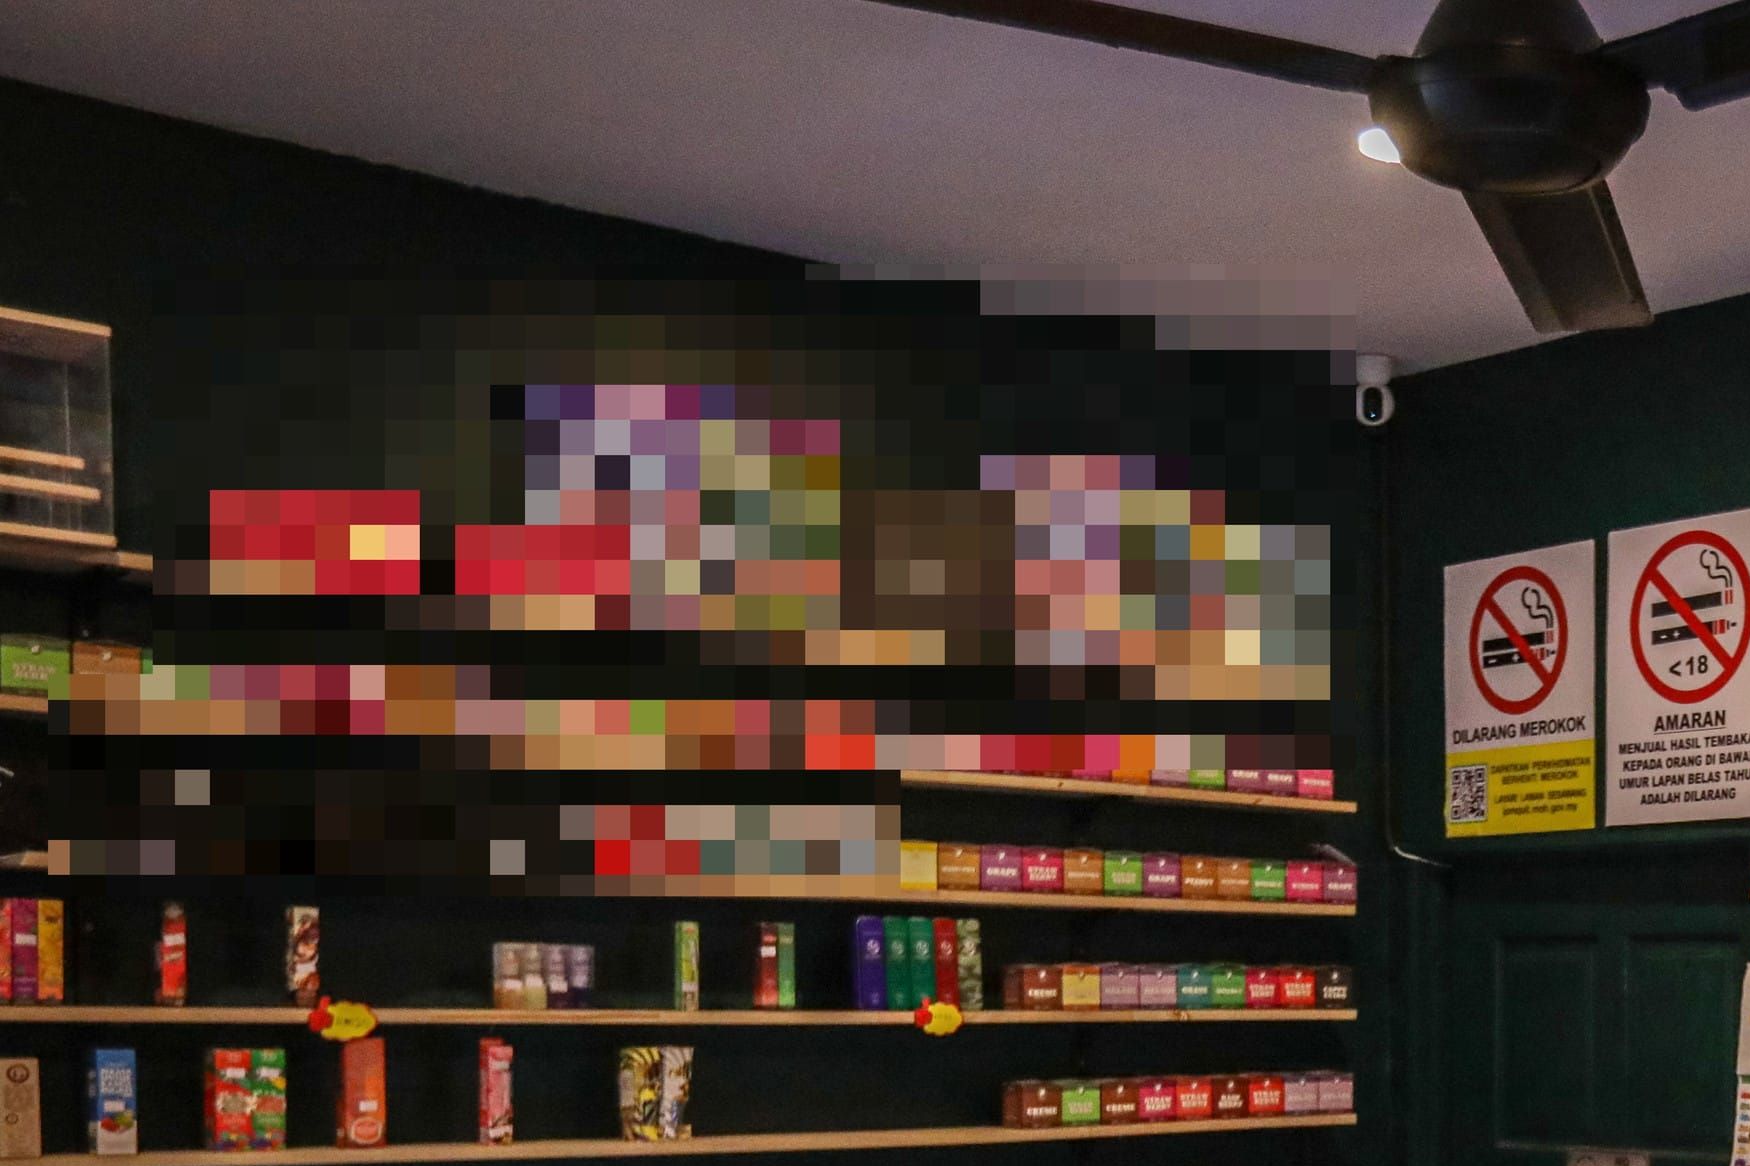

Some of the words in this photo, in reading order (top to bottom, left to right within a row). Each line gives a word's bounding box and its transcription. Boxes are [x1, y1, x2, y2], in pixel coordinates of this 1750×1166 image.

[1452, 724, 1517, 744] DILARANG
[1520, 715, 1587, 737] MEROKOK
[1654, 710, 1726, 732] AMARAN
[1618, 740, 1667, 754] MENJUAL
[1670, 737, 1701, 750] HASIL
[1622, 758, 1662, 772] KEPADA
[1665, 754, 1702, 769] ORANG
[1705, 753, 1716, 765] DI
[1618, 776, 1650, 789] UMUR
[1652, 773, 1685, 787] LAPAN
[1687, 770, 1721, 784] BELAS
[1640, 792, 1681, 805] ADALAH
[1683, 788, 1736, 802] DILARANG
